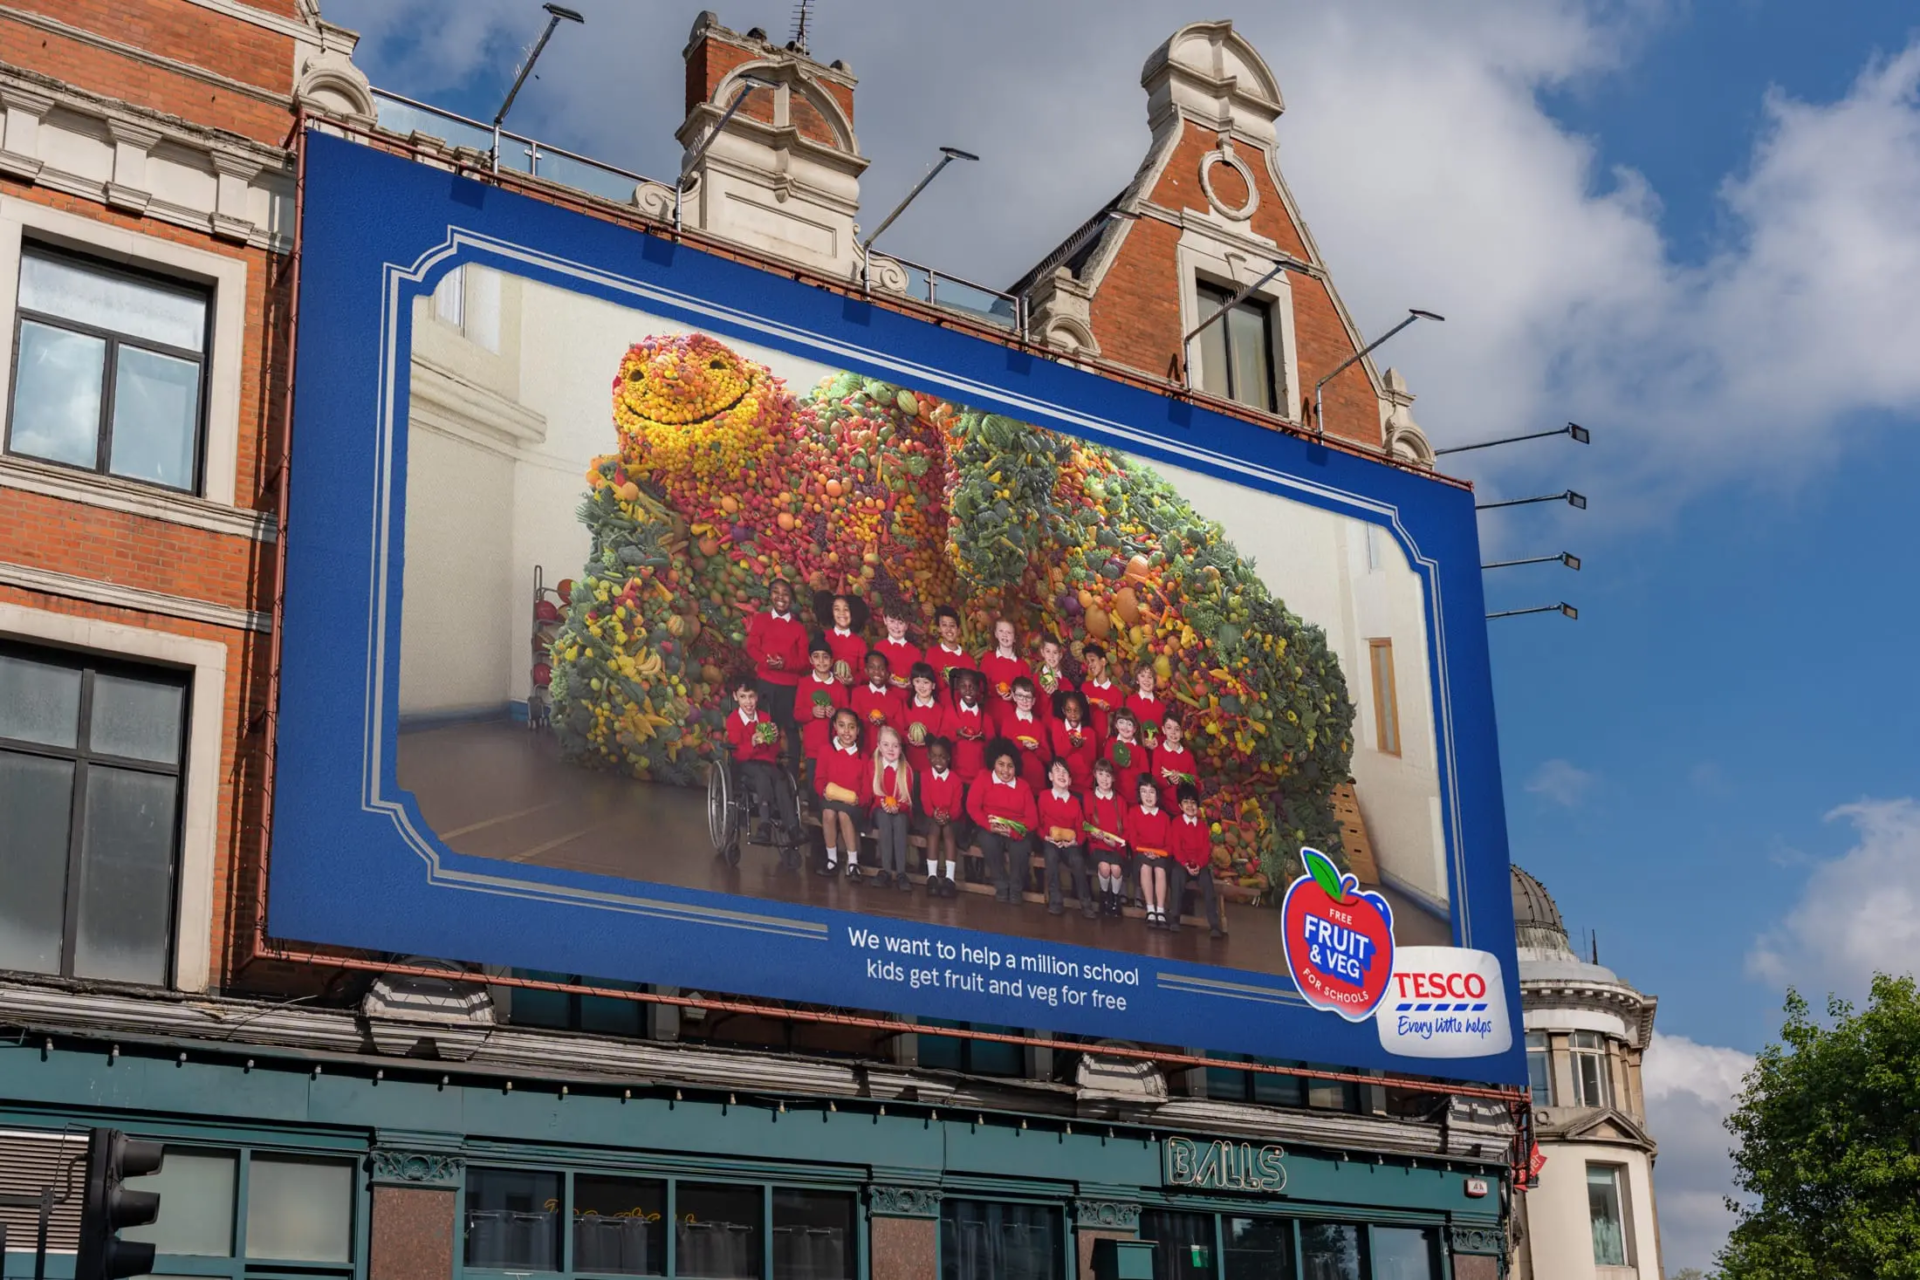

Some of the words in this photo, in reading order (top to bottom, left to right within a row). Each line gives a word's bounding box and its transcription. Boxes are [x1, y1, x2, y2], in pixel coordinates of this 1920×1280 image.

[1329, 908, 1352, 925] FREE
[1304, 914, 1369, 959] FRUIT
[847, 926, 880, 949] We
[884, 936, 931, 957] want
[936, 940, 956, 960] to
[961, 943, 1001, 970] help
[1005, 953, 1016, 969] a
[1021, 954, 1079, 978] million
[1083, 963, 1139, 986] school
[1309, 944, 1322, 965] &
[1326, 949, 1360, 979] VEG
[866, 958, 904, 981] kids
[909, 968, 940, 988] get
[944, 970, 985, 993] fruit
[988, 979, 1023, 998] and
[1027, 984, 1058, 1006] veg
[1061, 985, 1088, 1005] for
[1091, 989, 1127, 1011] free
[1302, 968, 1322, 991] FOR
[1323, 986, 1369, 1004] SCHOOLS
[1393, 972, 1486, 999] TESCO
[1397, 1015, 1433, 1040] Every
[1435, 1016, 1462, 1033] little
[1465, 1016, 1492, 1040] helps
[1168, 1136, 1287, 1192] BALLS
